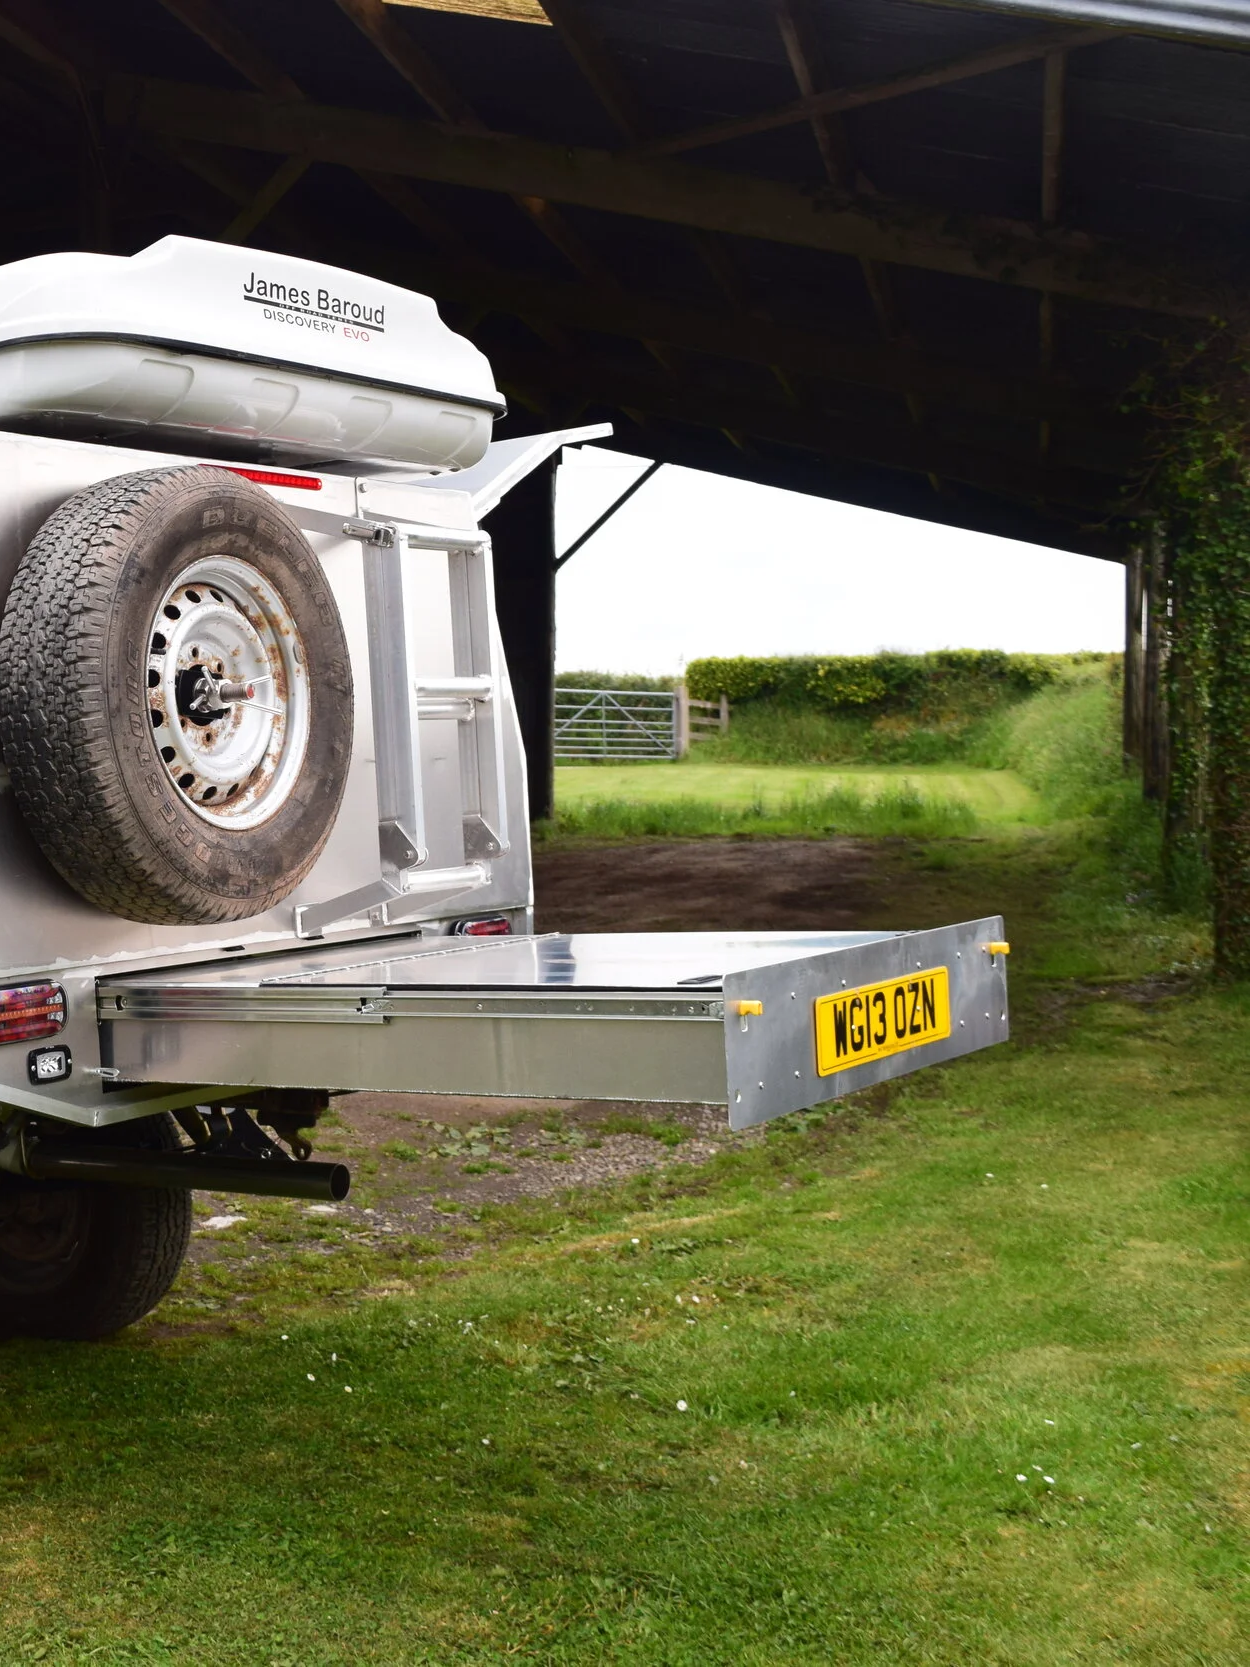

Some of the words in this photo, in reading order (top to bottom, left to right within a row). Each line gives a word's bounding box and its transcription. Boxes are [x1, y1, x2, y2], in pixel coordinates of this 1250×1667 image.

[243, 271, 310, 307] James
[317, 289, 385, 326] Baroud
[263, 308, 336, 334] DISCOVERY
[343, 327, 370, 342] EVO
[300, 308, 323, 317] ROAD
[121, 638, 261, 882] IDGESTONE
[833, 991, 887, 1058] WG13
[893, 978, 937, 1039] OZN
